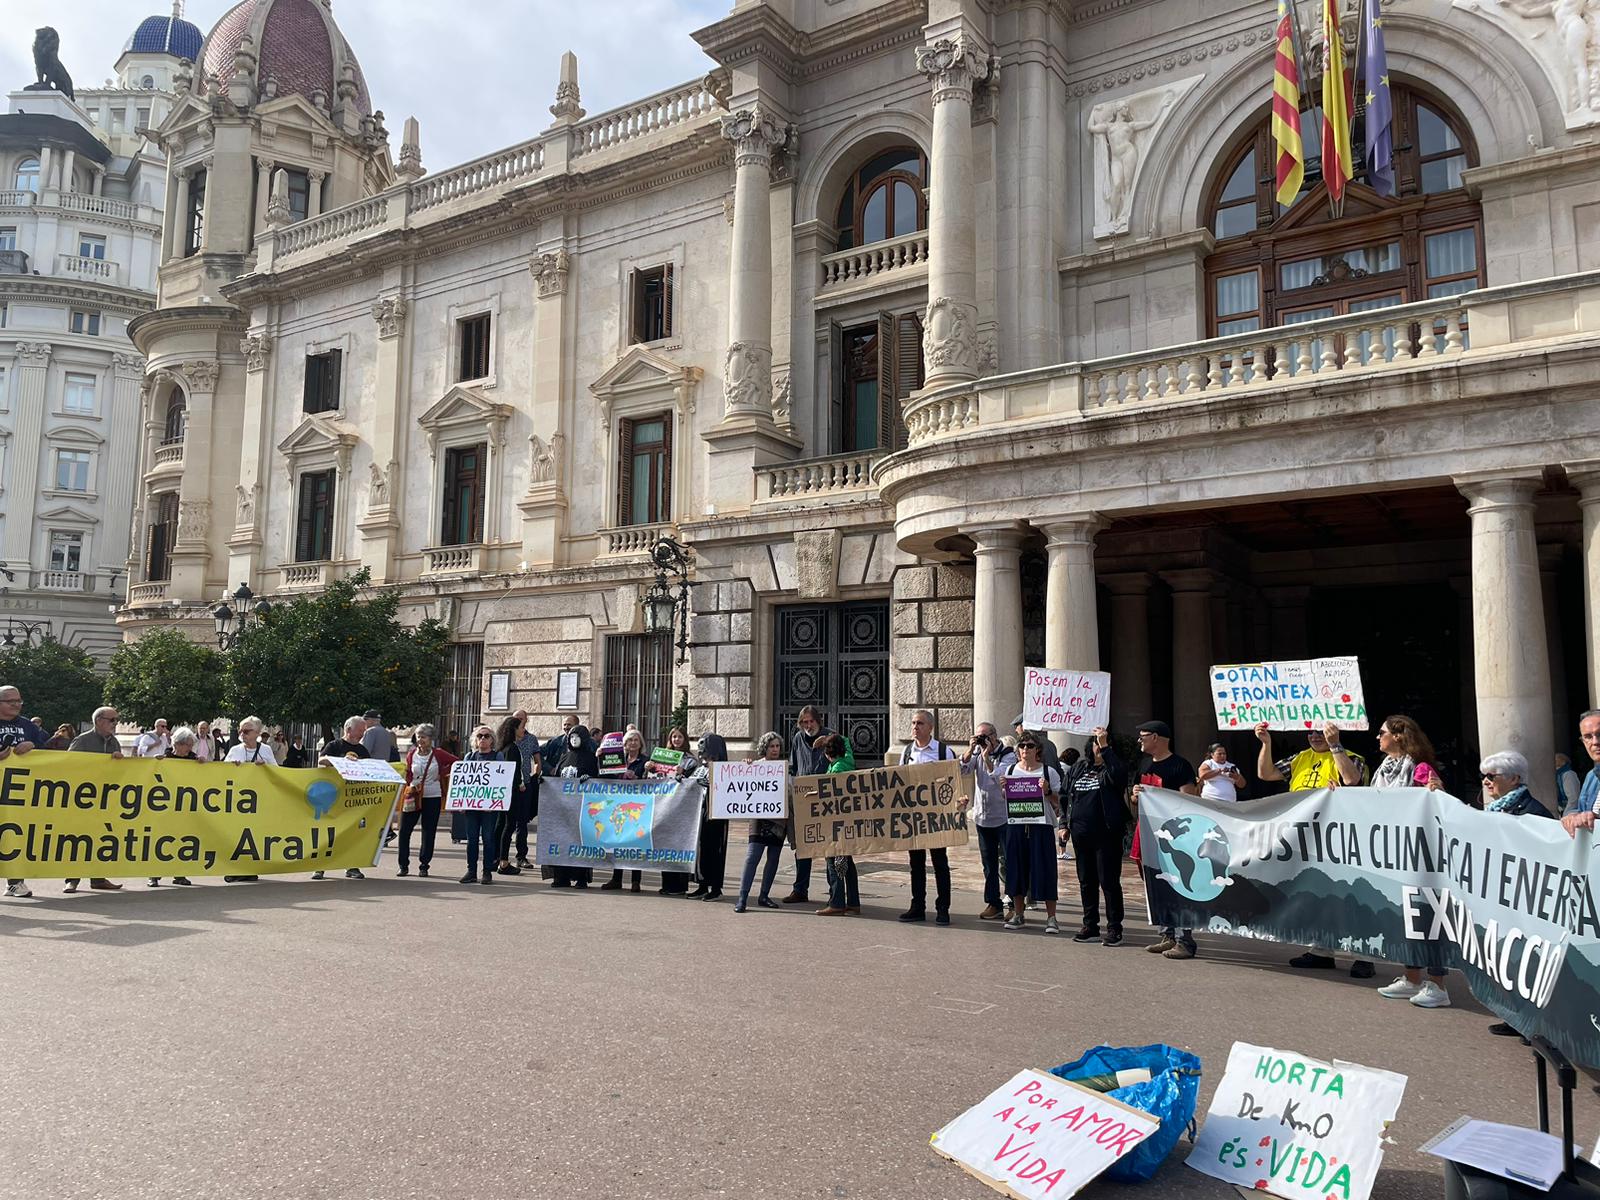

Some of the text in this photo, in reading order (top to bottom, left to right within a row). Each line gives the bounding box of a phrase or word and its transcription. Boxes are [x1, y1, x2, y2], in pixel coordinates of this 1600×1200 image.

[1029, 670, 1092, 690] Posem la
[1032, 691, 1098, 708] vida en el
[1043, 710, 1082, 724] centre
[454, 762, 505, 774] ZONAS de
[721, 764, 784, 781] MORATORIA
[452, 773, 490, 786] BAJAS
[562, 782, 575, 793] EL
[577, 782, 608, 794] CLIMA
[610, 783, 641, 794] EXIGE
[727, 780, 778, 793] AVIONES
[817, 769, 905, 799] EL CLIMA
[0, 768, 257, 820] Emergència
[450, 786, 507, 799] EMISIONES
[452, 799, 504, 809] EN VLC YA
[726, 802, 782, 813] CRUCEROS
[811, 793, 885, 818] EXIGEIX
[804, 822, 825, 844] EL
[0, 822, 336, 870] Climàtica, Ara!!
[548, 844, 695, 863] EL FUTURO EXIGE ESPERANZ
[1241, 812, 1362, 867] JUSTÍCIA
[1481, 848, 1491, 899] I
[1254, 1055, 1344, 1100] HORTA
[1238, 1092, 1263, 1121] De
[993, 1107, 1042, 1135] A LA
[1013, 1080, 1145, 1157] POR AMOR
[994, 1133, 1067, 1193] VIDA
[1218, 1137, 1351, 1200] és VIDA
